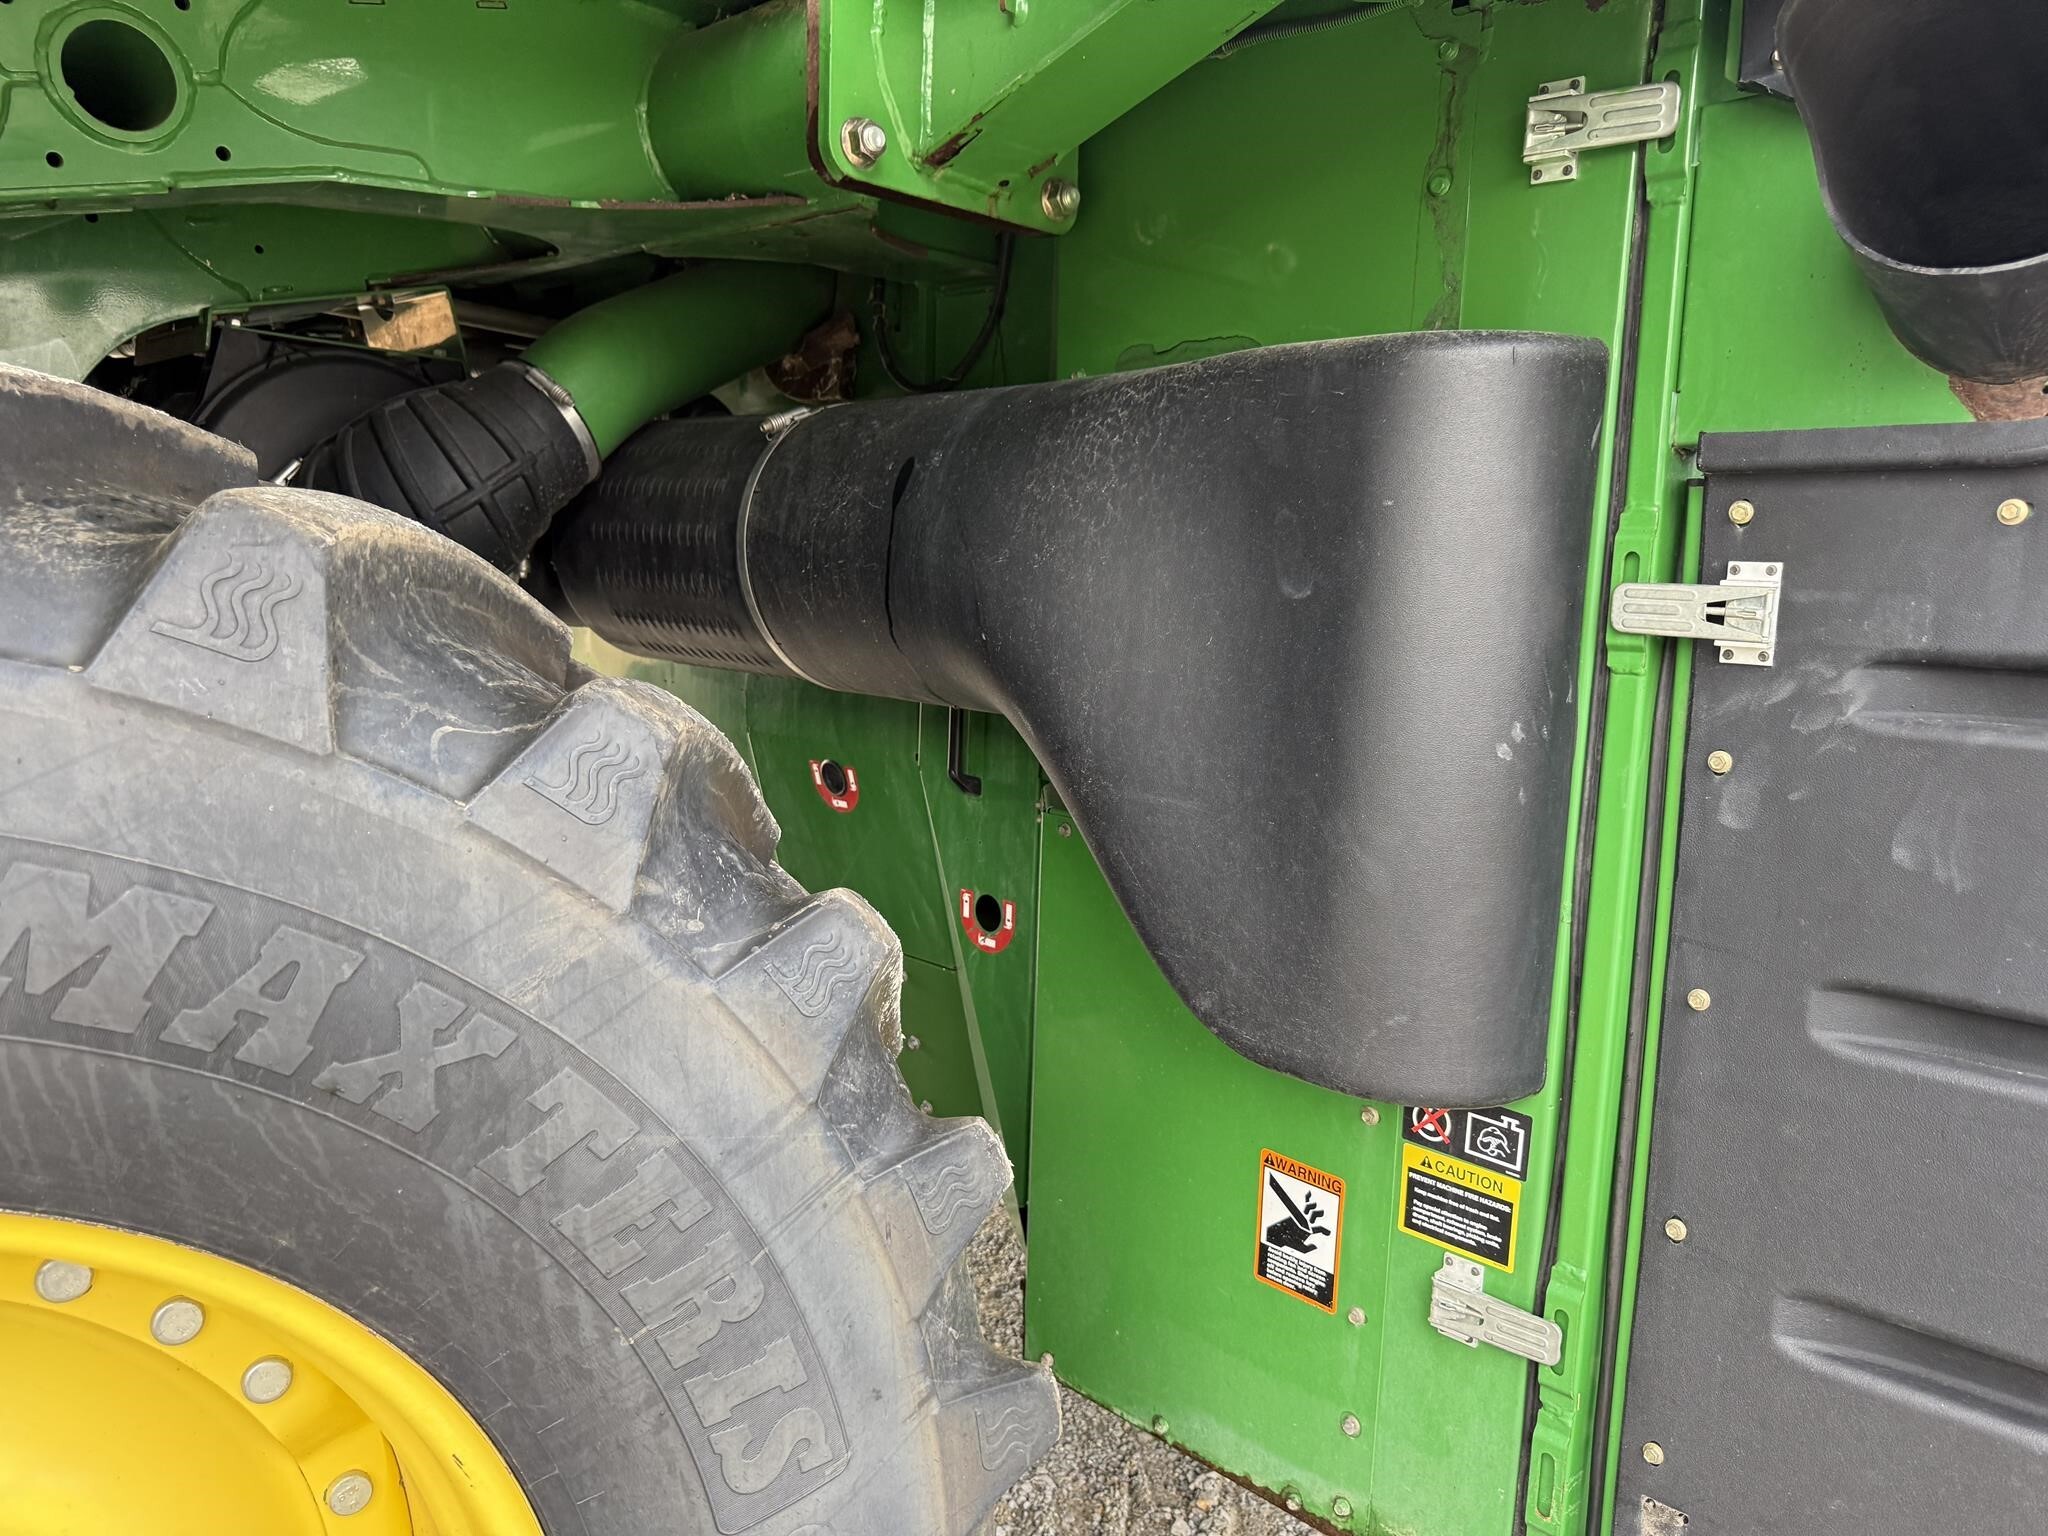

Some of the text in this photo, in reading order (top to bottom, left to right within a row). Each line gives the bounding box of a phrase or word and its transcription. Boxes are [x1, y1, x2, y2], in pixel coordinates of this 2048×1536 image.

[1275, 1158, 1342, 1193] WARNING
[1408, 1171, 1511, 1213] PREVENT MACHINE FIRE HAZARDS:
[1434, 1159, 1503, 1194] CAUTION
[475, 1066, 833, 1495] TERIS
